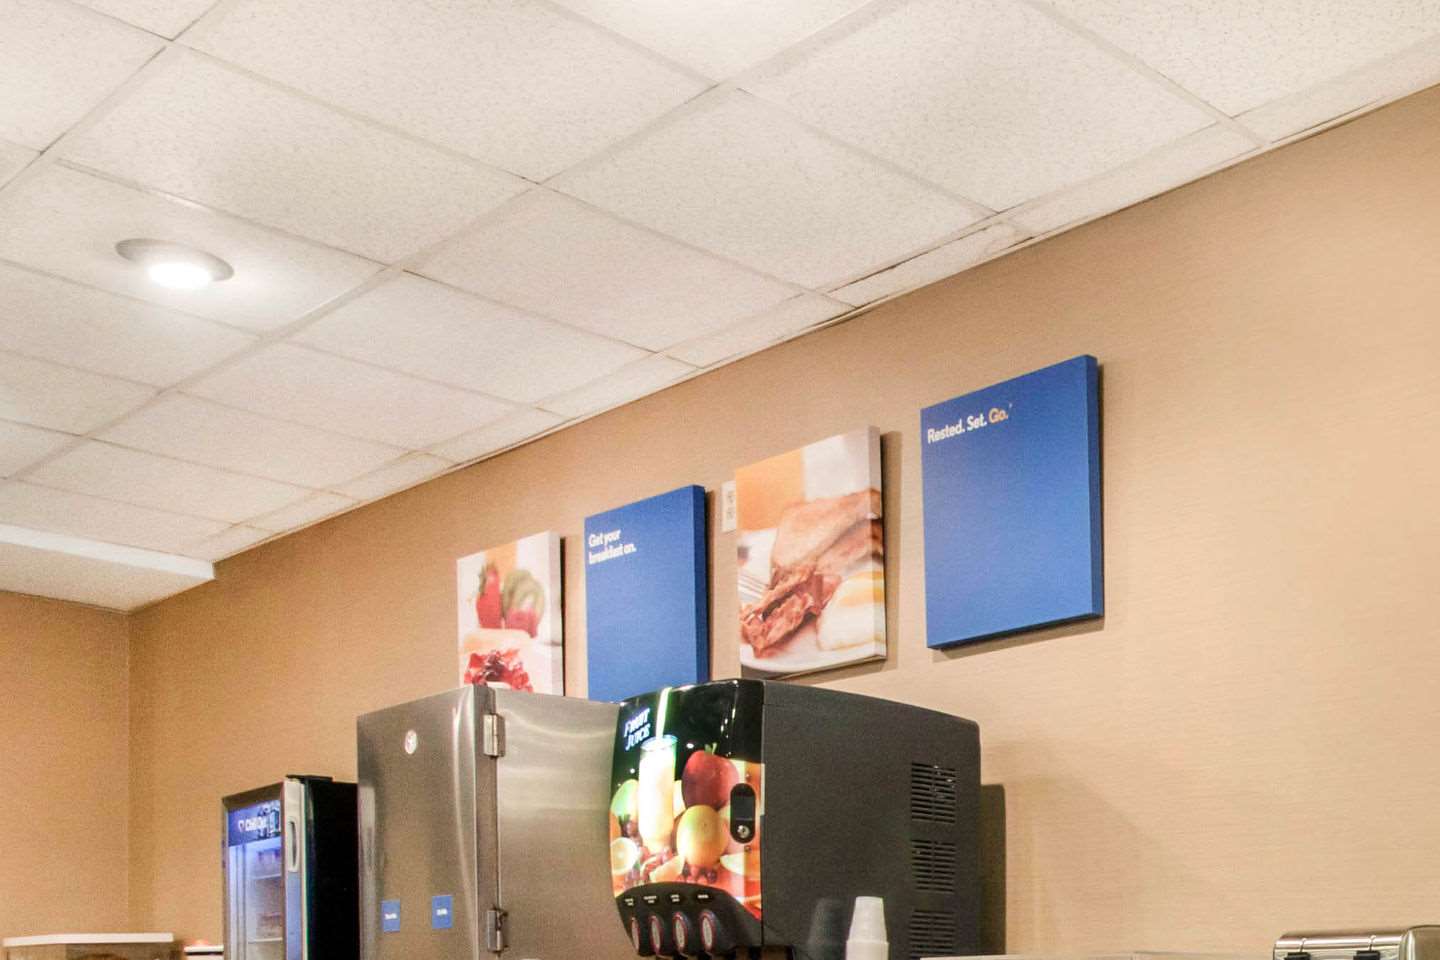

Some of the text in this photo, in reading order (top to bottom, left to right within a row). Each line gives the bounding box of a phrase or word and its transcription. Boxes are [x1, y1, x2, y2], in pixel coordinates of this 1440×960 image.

[927, 418, 966, 444] Rested.
[966, 413, 988, 431] Set.
[623, 708, 651, 738] FRUIT
[624, 723, 651, 751] JUICE
